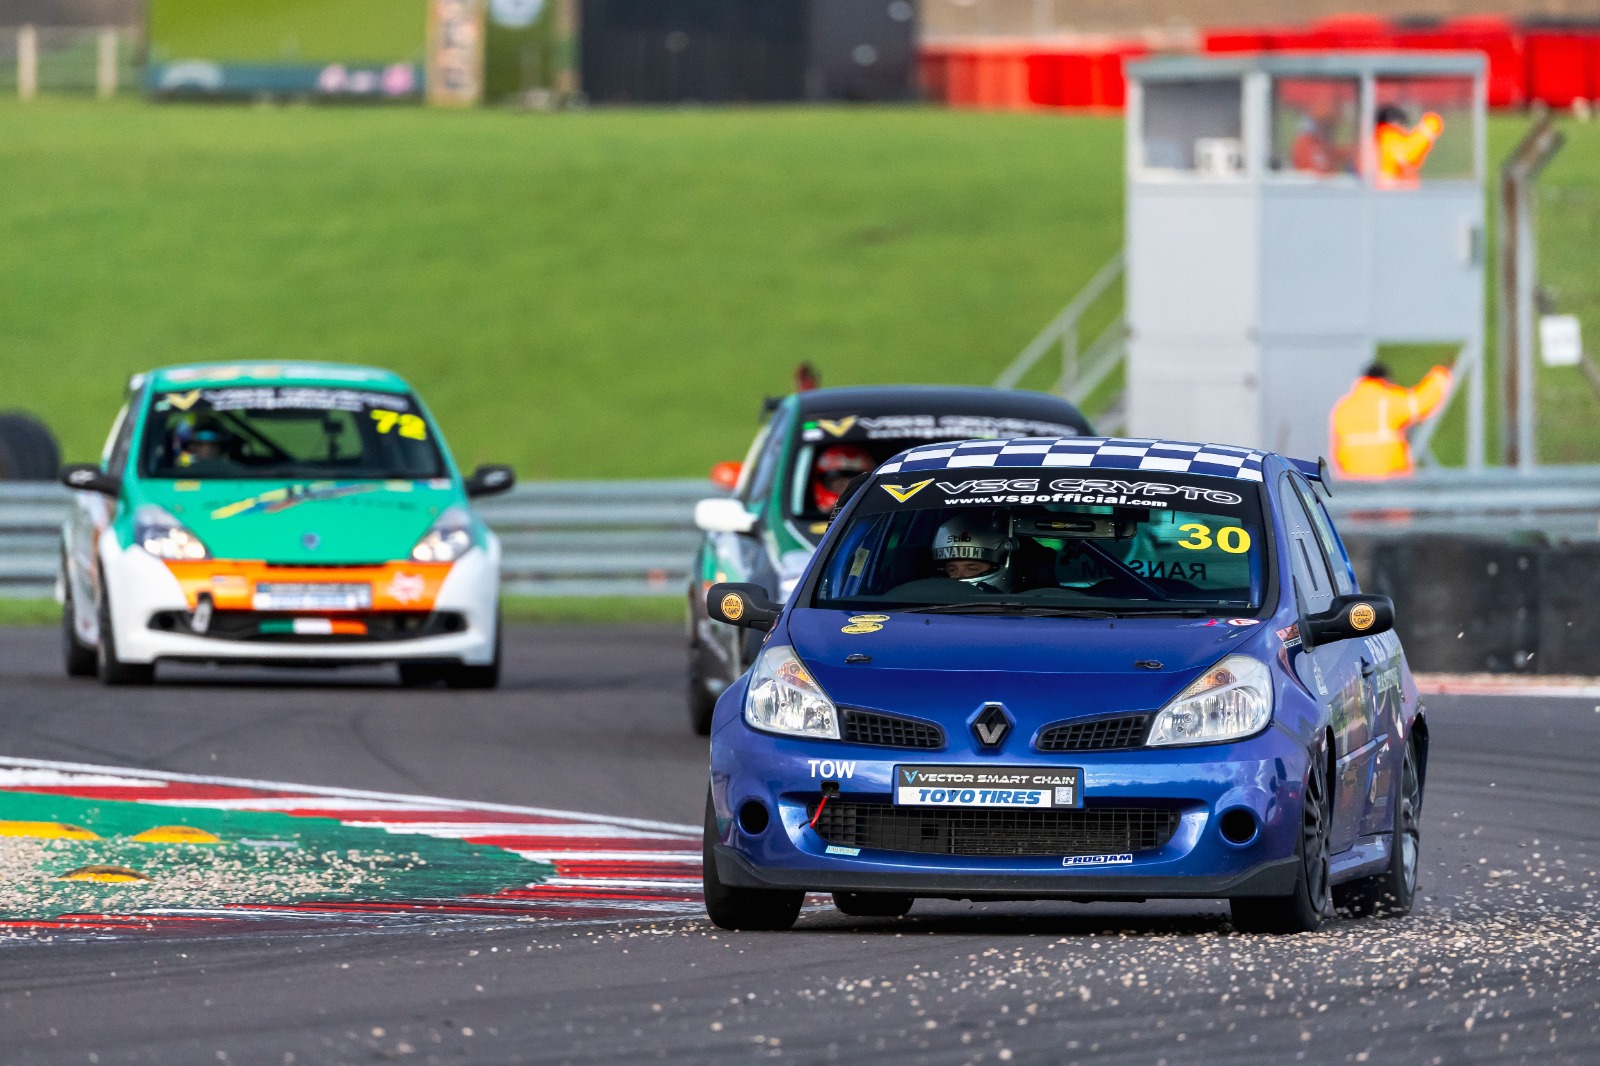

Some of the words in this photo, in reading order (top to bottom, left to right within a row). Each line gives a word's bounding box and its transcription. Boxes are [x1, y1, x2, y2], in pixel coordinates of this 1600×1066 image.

[370, 408, 427, 441] 72
[935, 478, 1041, 495] VSG
[1049, 478, 1243, 505] CRYPTO
[944, 493, 1168, 508] www.vsgofficial.com
[1177, 523, 1251, 554] 30
[807, 759, 857, 779] TOW
[918, 773, 974, 783] VECTOR
[976, 775, 1030, 785] SMART
[1032, 775, 1076, 785] CHAIN
[918, 788, 976, 804] TOYO
[978, 790, 1042, 805] TIRES
[1063, 854, 1133, 864] FROGJAM
